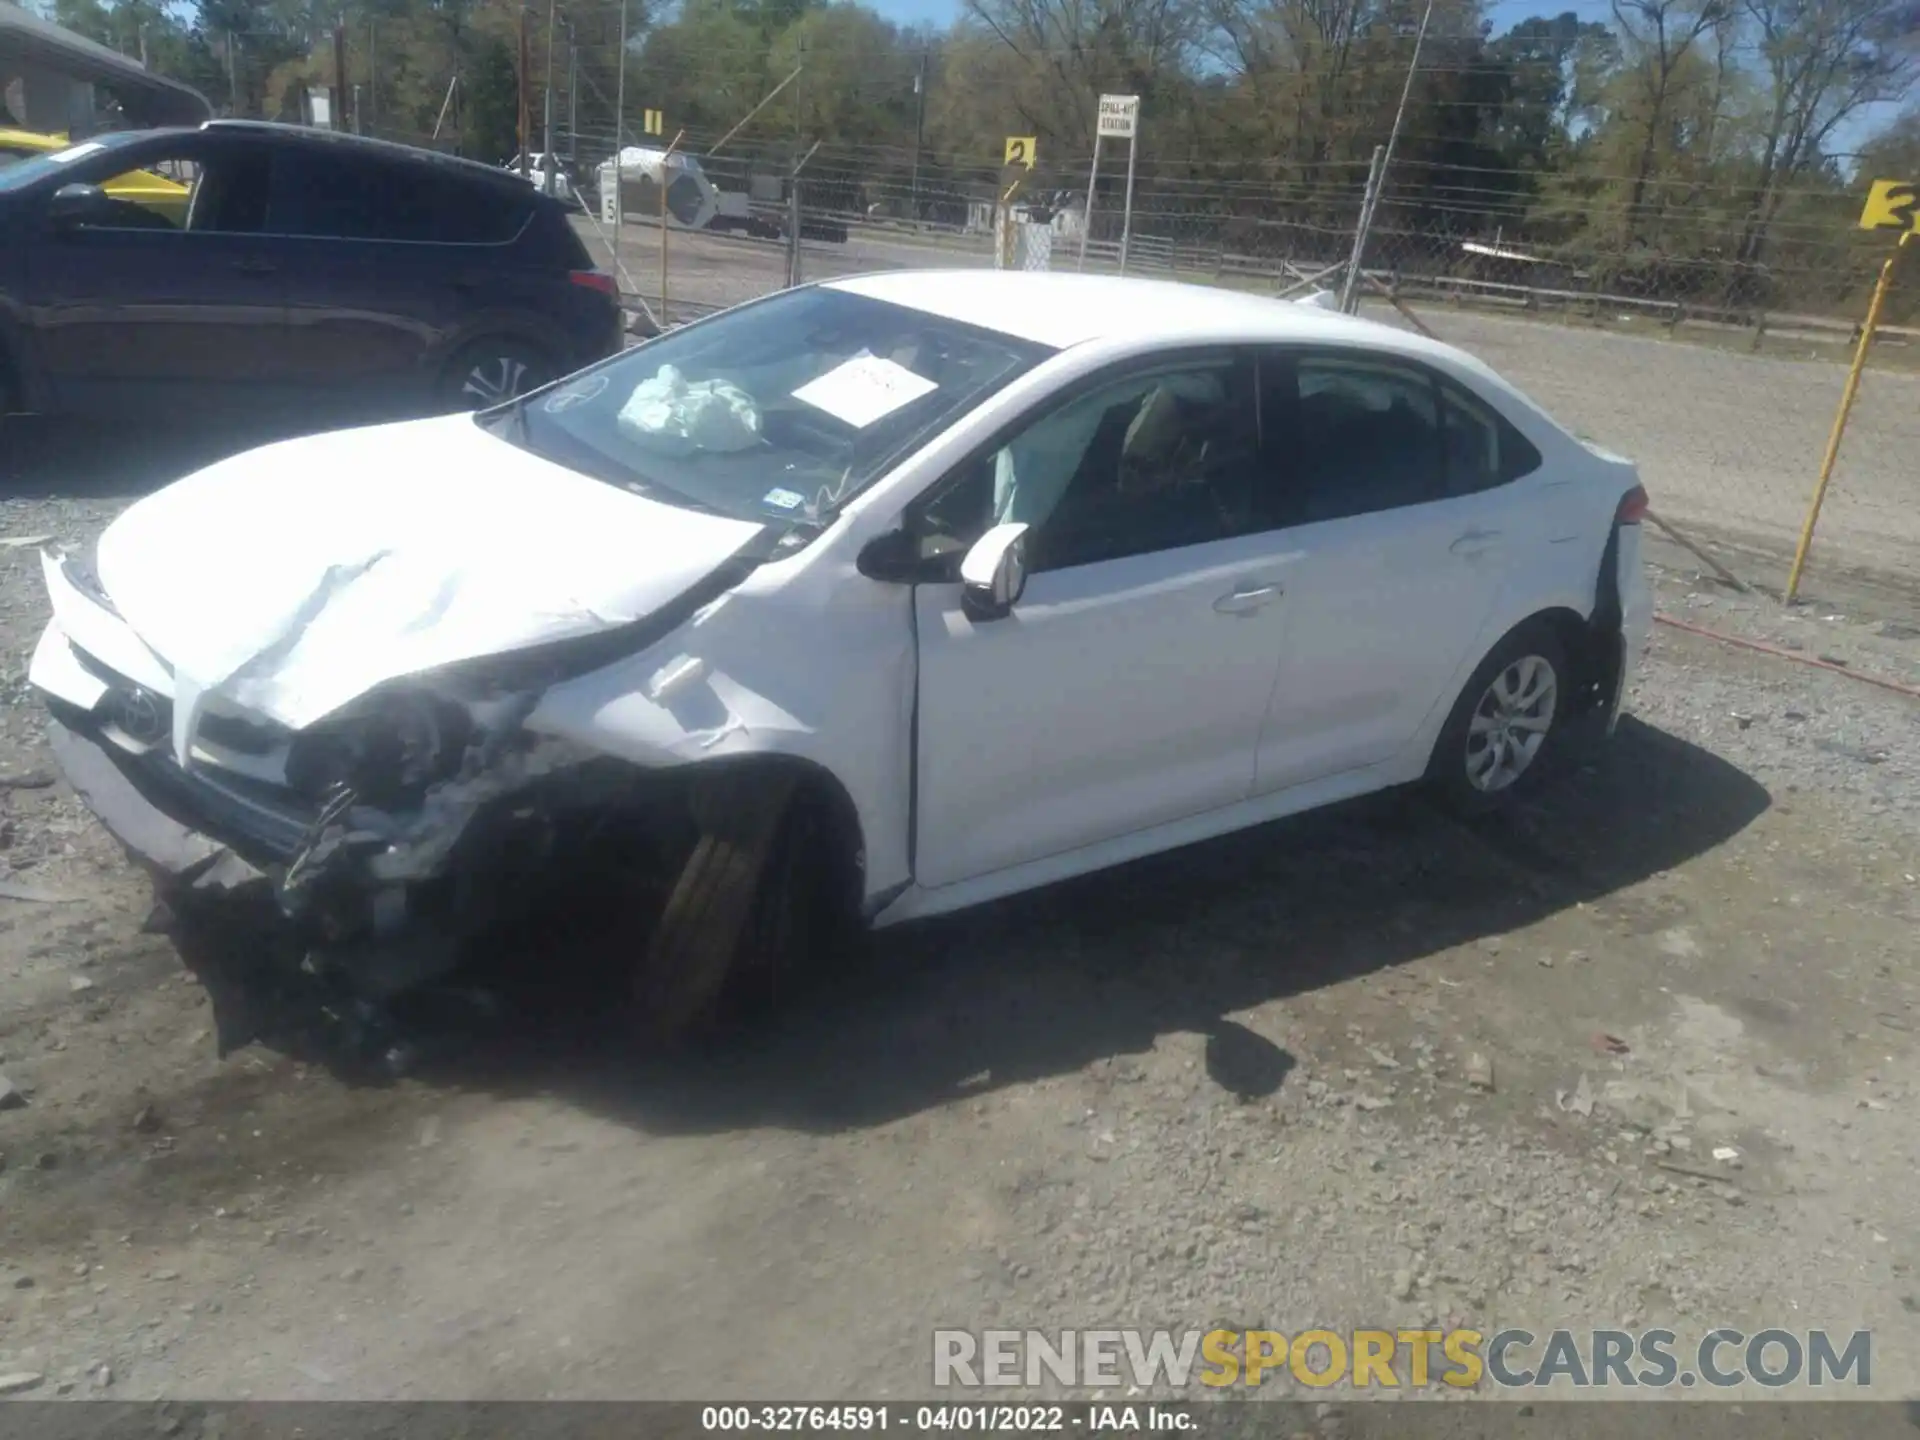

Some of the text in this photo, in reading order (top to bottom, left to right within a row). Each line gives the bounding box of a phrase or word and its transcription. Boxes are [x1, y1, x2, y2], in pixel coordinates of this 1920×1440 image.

[1101, 117, 1131, 130] STATION
[1008, 140, 1028, 166] 2
[1882, 186, 1920, 230] 3
